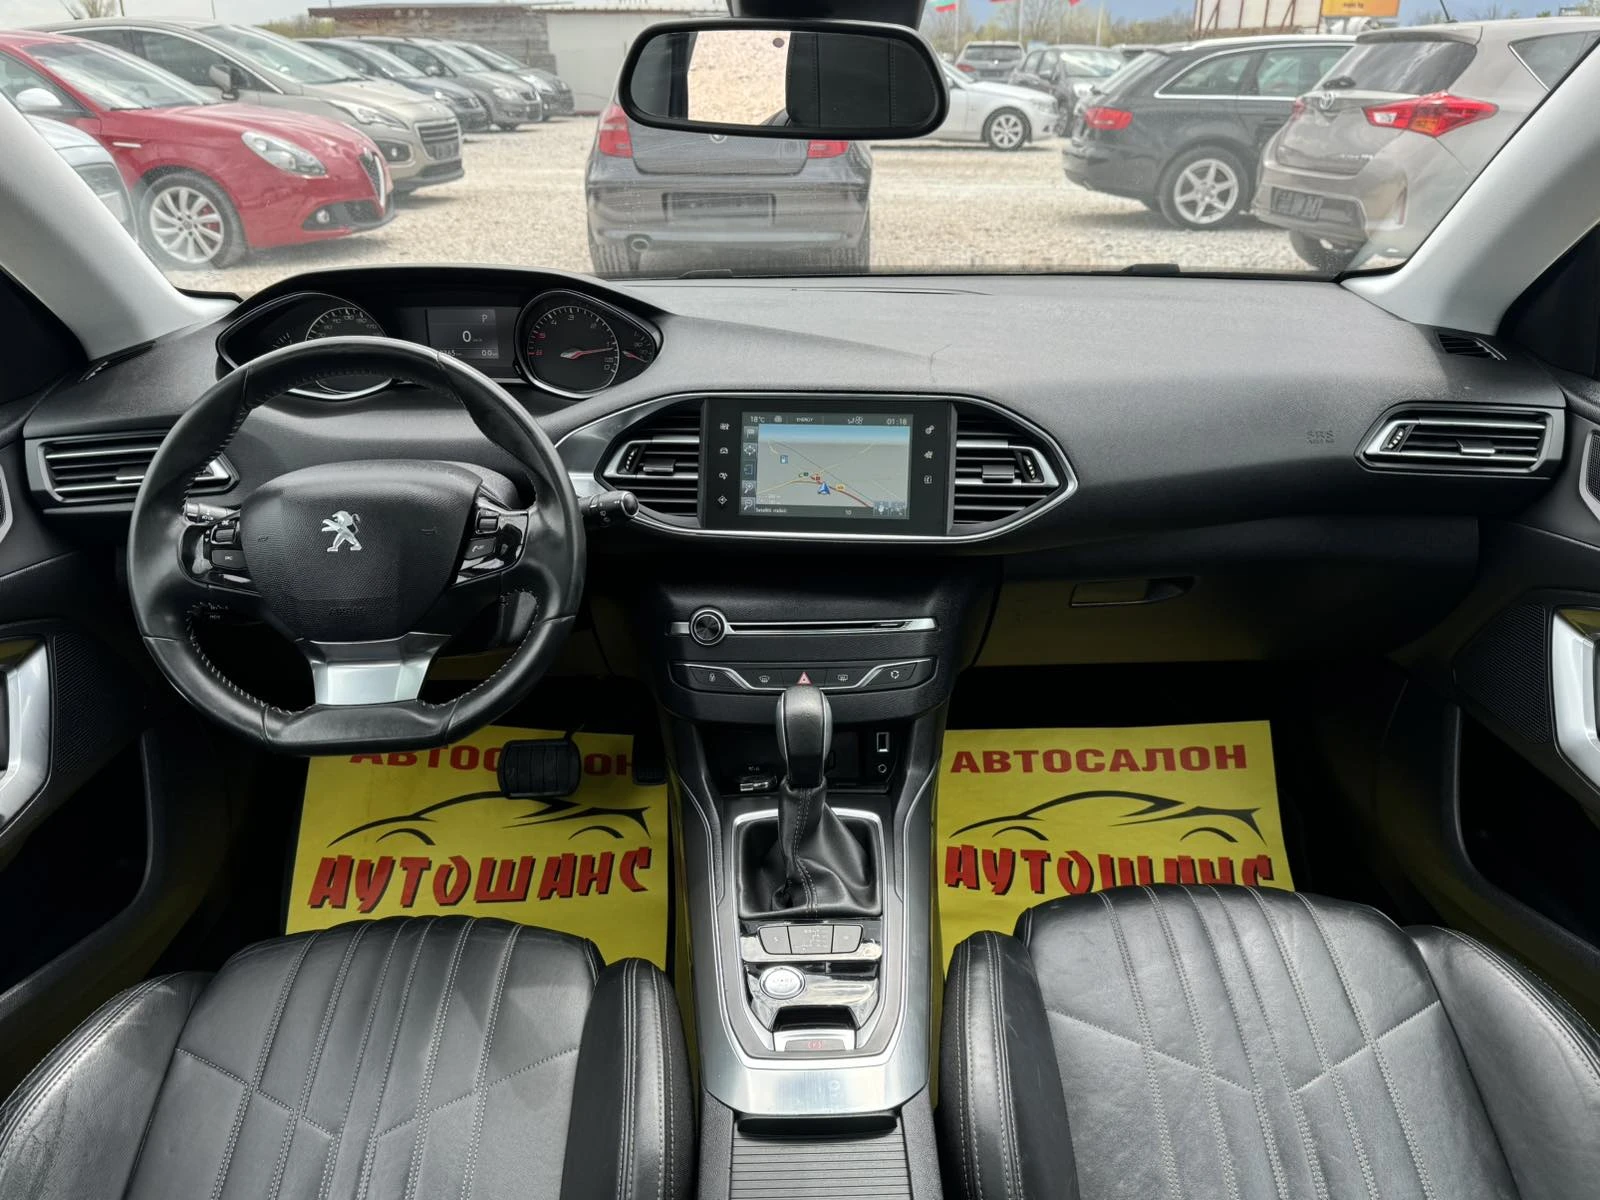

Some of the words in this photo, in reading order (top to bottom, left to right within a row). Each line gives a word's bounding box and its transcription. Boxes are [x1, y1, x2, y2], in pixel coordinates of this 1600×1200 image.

[462, 330, 471, 342] 0
[950, 744, 1247, 773] АВТОСАЛОН
[307, 846, 652, 913] АУТОШАНС
